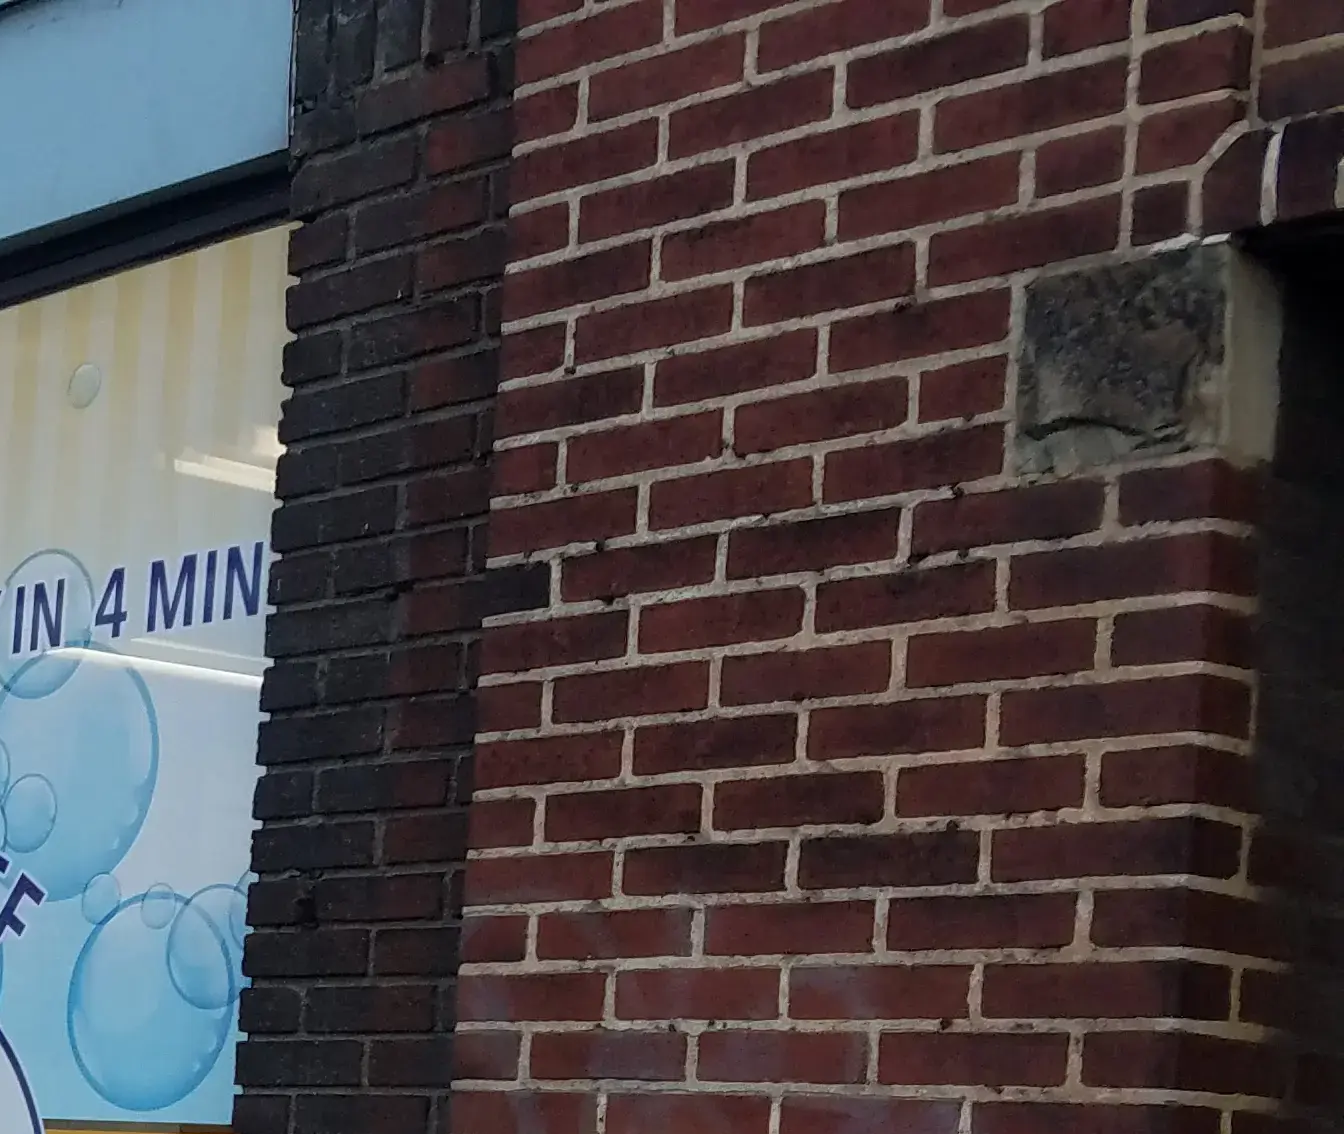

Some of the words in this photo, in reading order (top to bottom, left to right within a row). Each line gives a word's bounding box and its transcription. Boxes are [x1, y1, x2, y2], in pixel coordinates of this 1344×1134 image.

[12, 578, 65, 654] IN
[95, 568, 126, 638] 4
[146, 541, 264, 633] MIN
